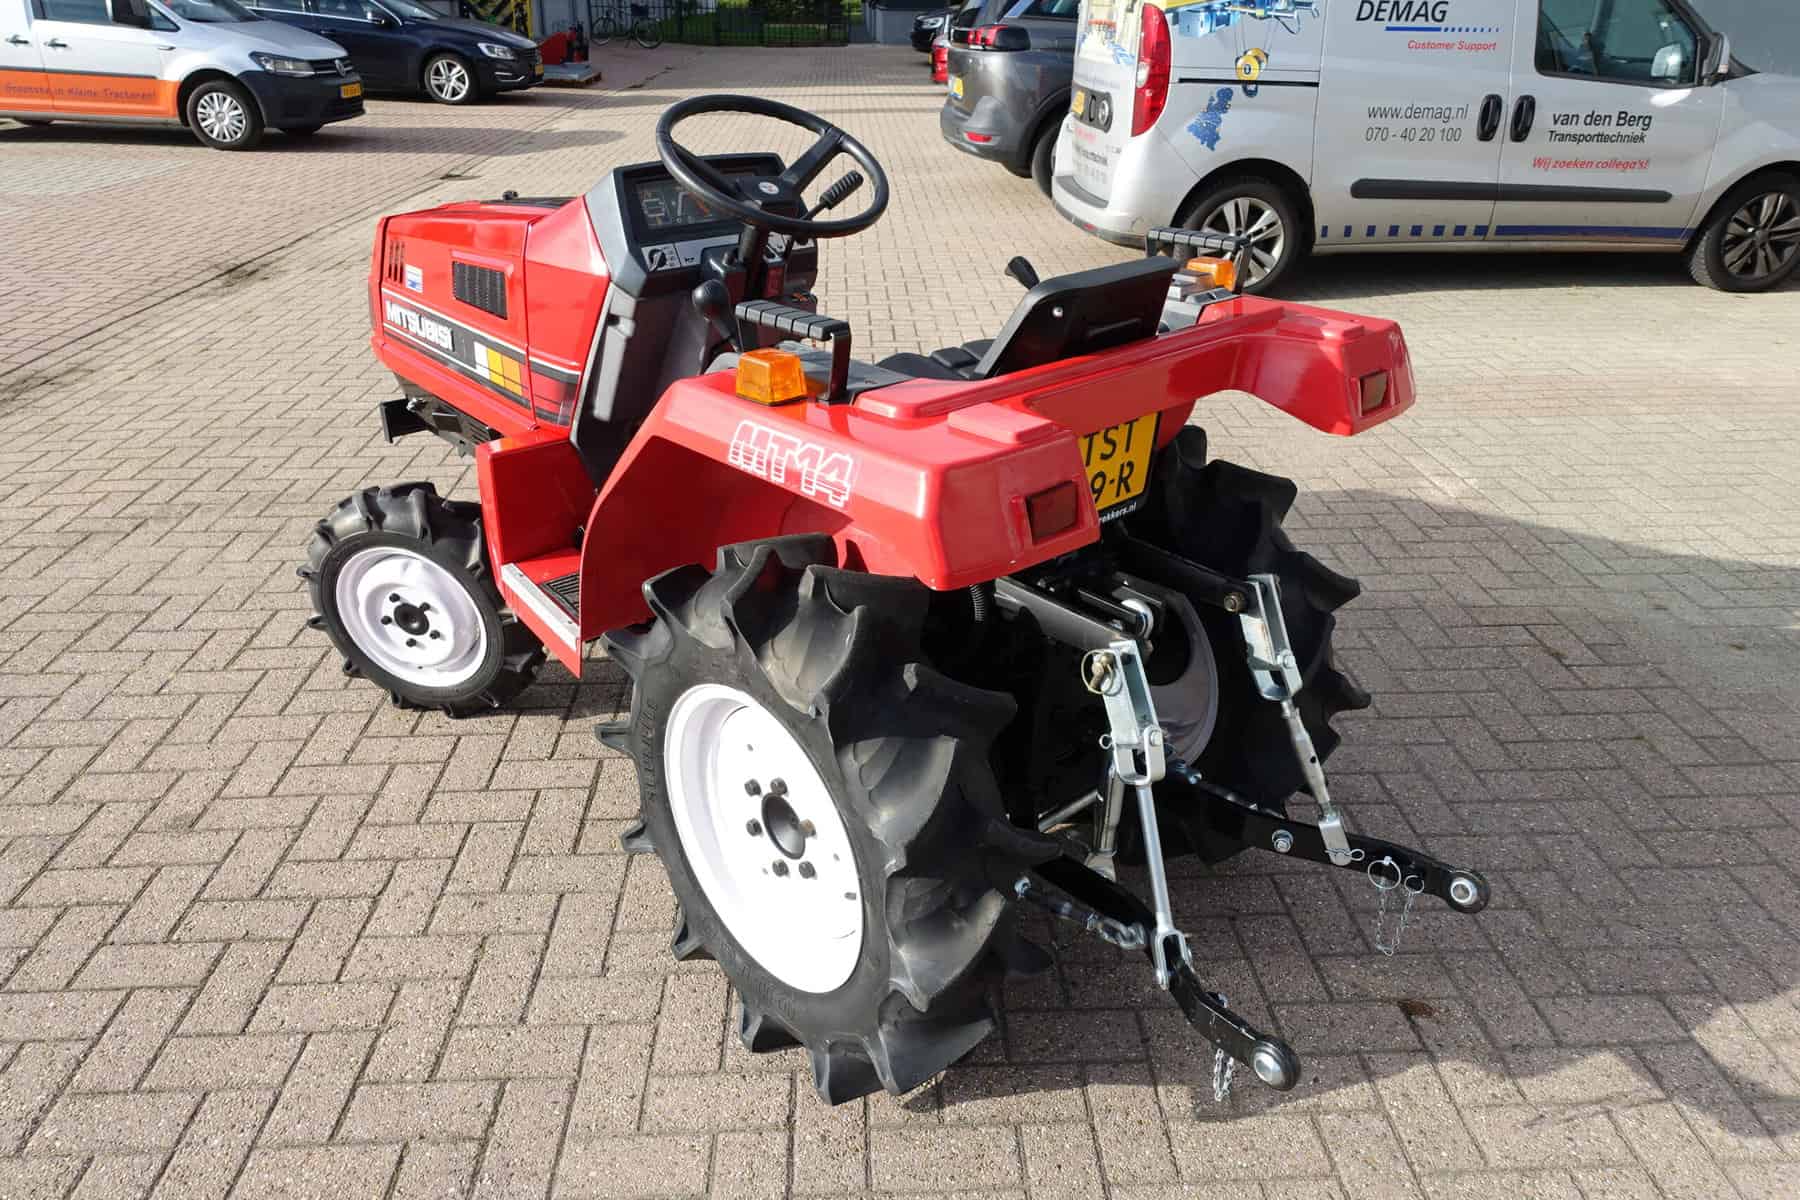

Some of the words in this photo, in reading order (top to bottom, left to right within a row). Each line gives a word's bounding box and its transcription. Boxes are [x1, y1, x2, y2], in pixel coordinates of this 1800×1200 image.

[1355, 0, 1449, 23] DEMAG
[1407, 39, 1456, 50] Customer
[1457, 40, 1497, 52] Support
[1367, 103, 1469, 124] www.demag.nl
[1552, 113, 1580, 126] van
[1583, 110, 1612, 127] den
[1615, 110, 1653, 131] Berg
[1365, 127, 1389, 142] 070
[1400, 127, 1417, 142] 40
[1418, 127, 1435, 142] 20
[1439, 127, 1462, 142] 100
[1548, 130, 1647, 144] Transporttechniek
[1532, 156, 1552, 171] Wij
[1552, 157, 1595, 169] zoeken
[1082, 417, 1140, 467] TST
[728, 419, 854, 508] MT14
[1090, 460, 1135, 504] 9-R
